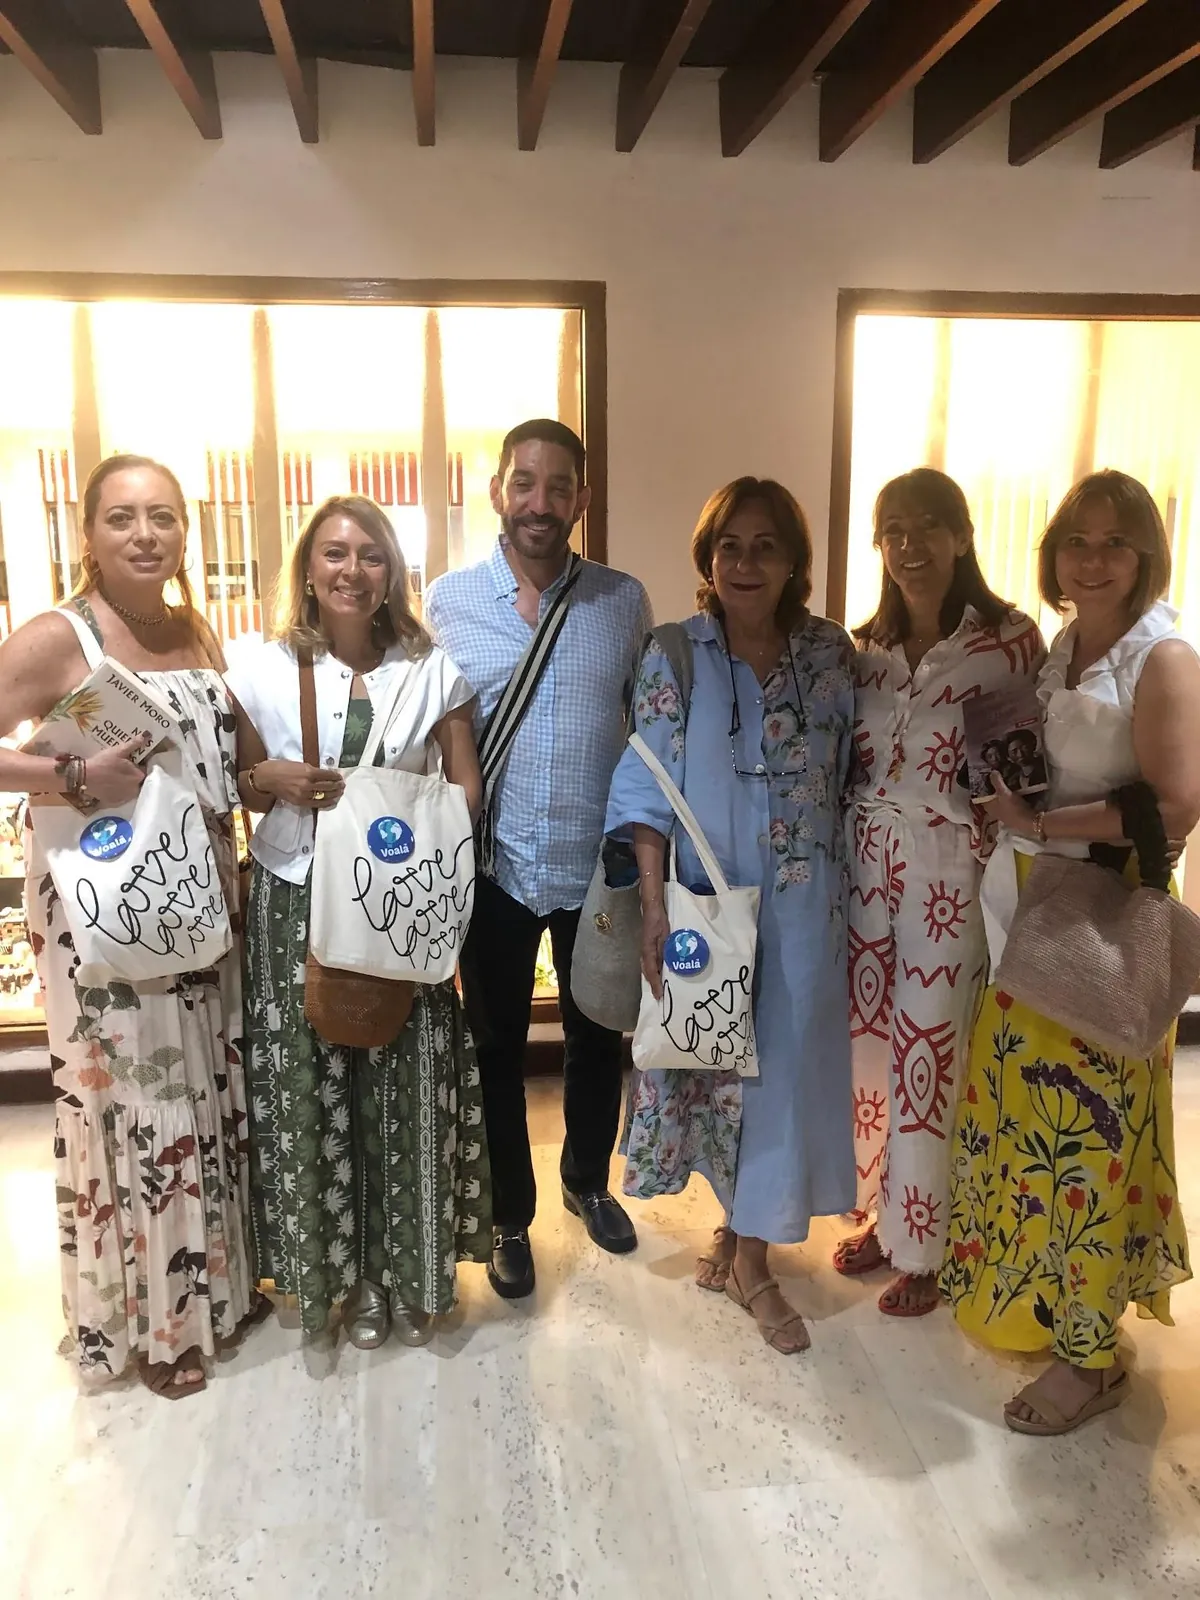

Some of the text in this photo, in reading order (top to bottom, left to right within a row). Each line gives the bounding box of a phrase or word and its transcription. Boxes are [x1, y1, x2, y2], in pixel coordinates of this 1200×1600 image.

[106, 673, 170, 729] JAVIER MORO
[103, 720, 145, 755] QUIEN
[131, 727, 153, 747] NS
[380, 843, 410, 858] Voalá
[672, 958, 701, 970] Voalá
